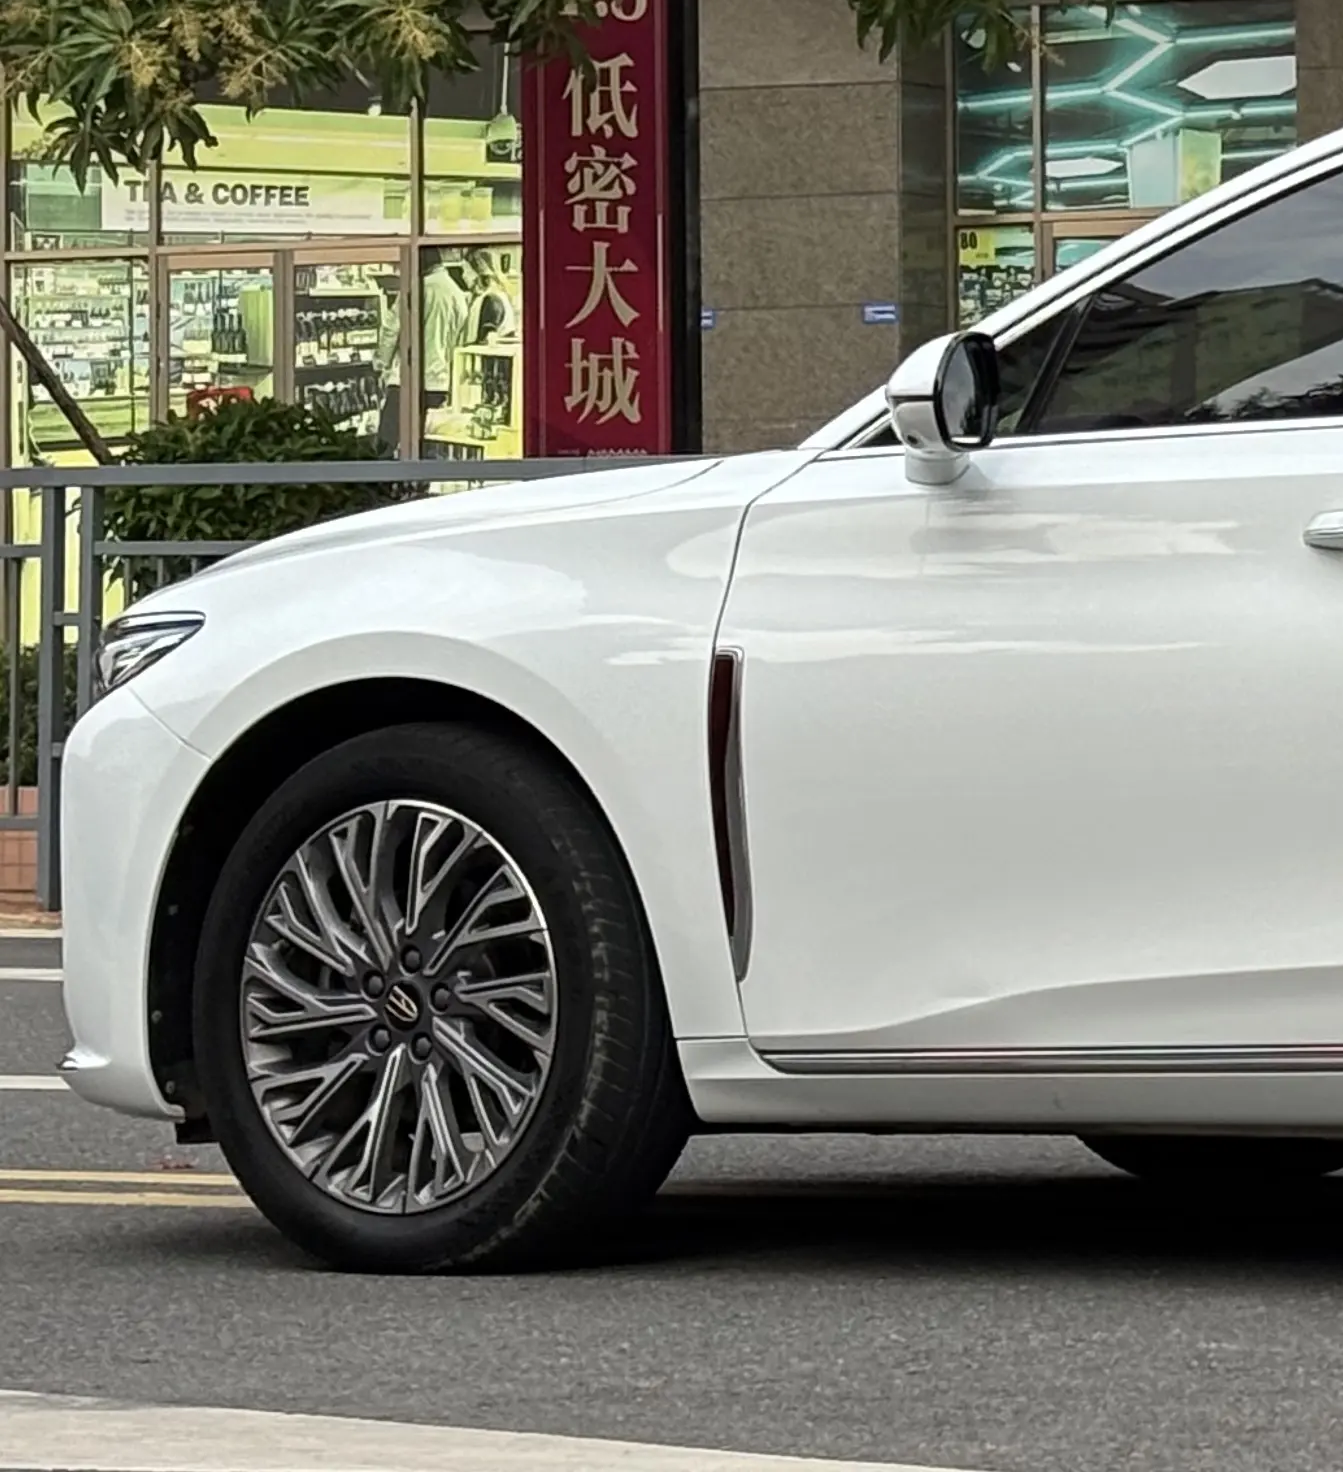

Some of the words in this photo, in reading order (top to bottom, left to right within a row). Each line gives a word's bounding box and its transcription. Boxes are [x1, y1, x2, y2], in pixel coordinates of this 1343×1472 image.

[184, 182, 204, 205] &
[212, 183, 310, 207] COFFEE
[562, 52, 642, 426] 低密大城
